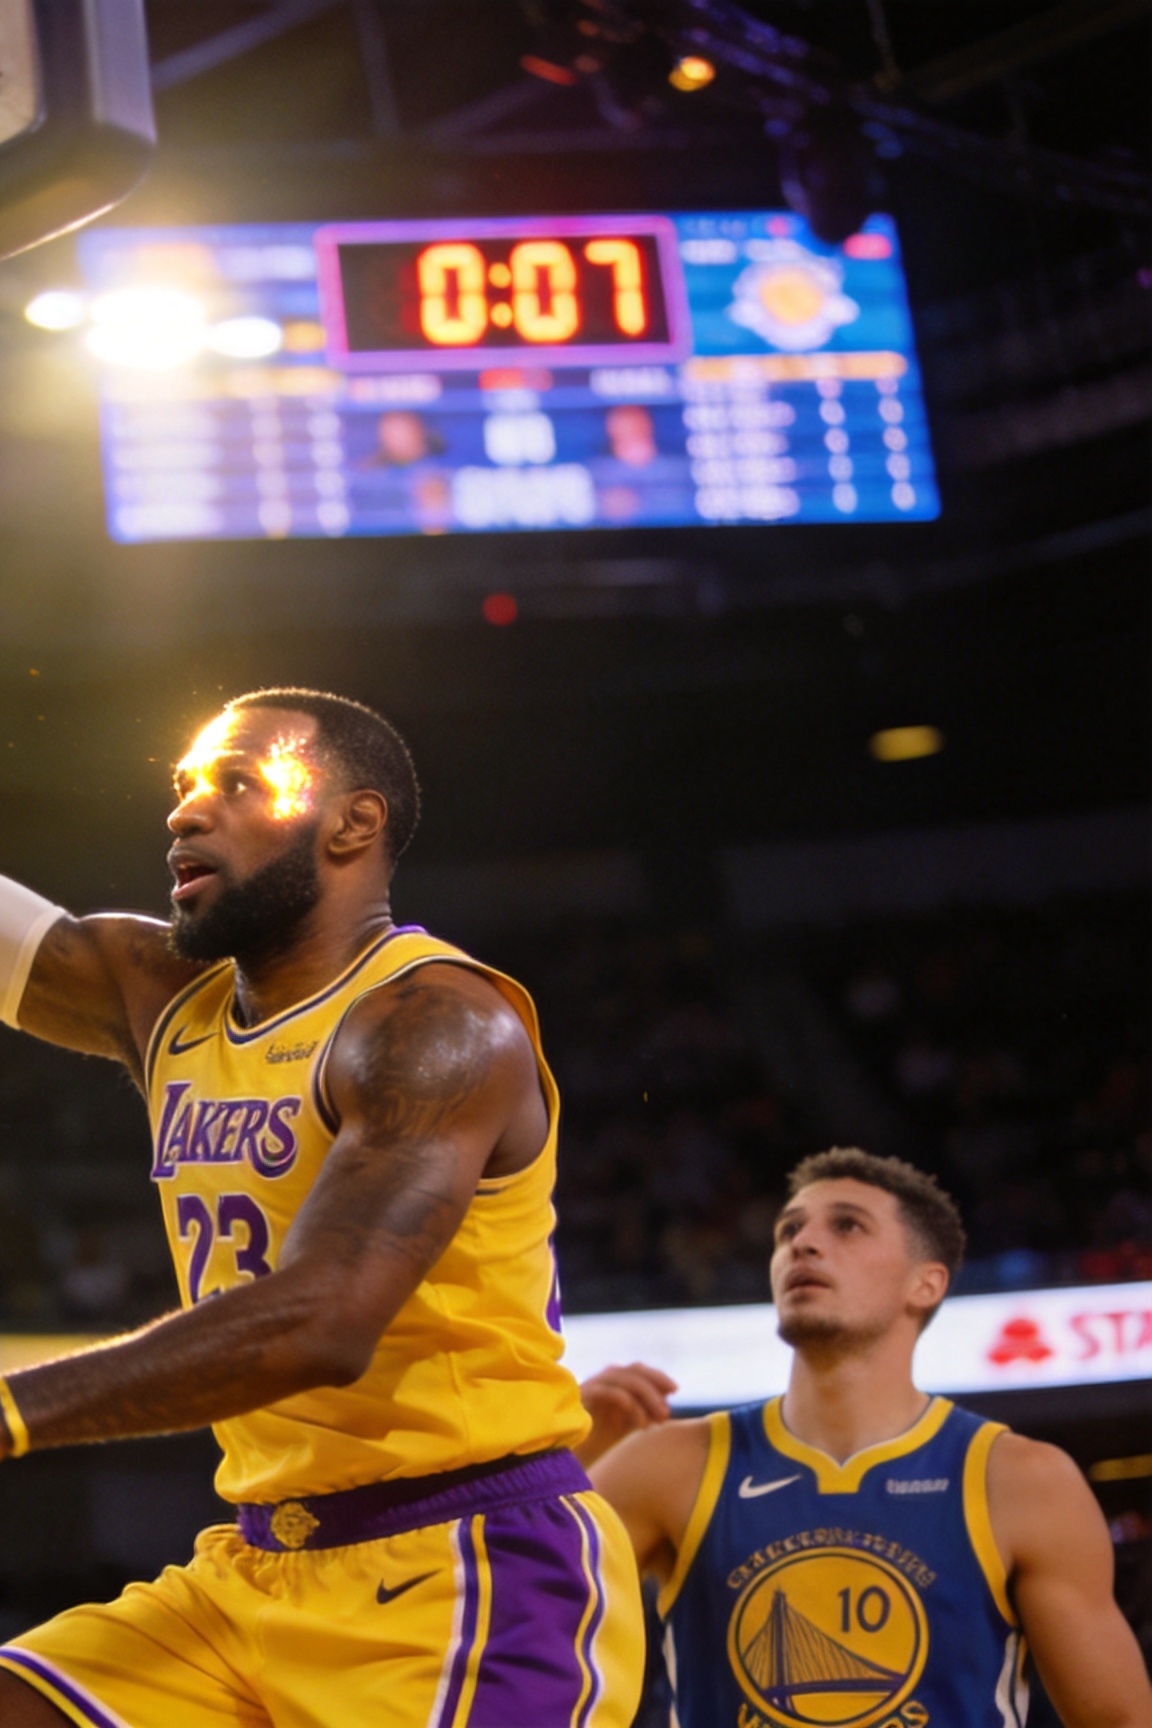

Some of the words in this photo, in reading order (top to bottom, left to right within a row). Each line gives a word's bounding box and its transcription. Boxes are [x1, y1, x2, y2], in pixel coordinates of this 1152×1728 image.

[417, 239, 645, 345] 0:07
[150, 1080, 302, 1181] LAKERS
[176, 1193, 273, 1303] 23
[837, 1585, 891, 1633] 10
